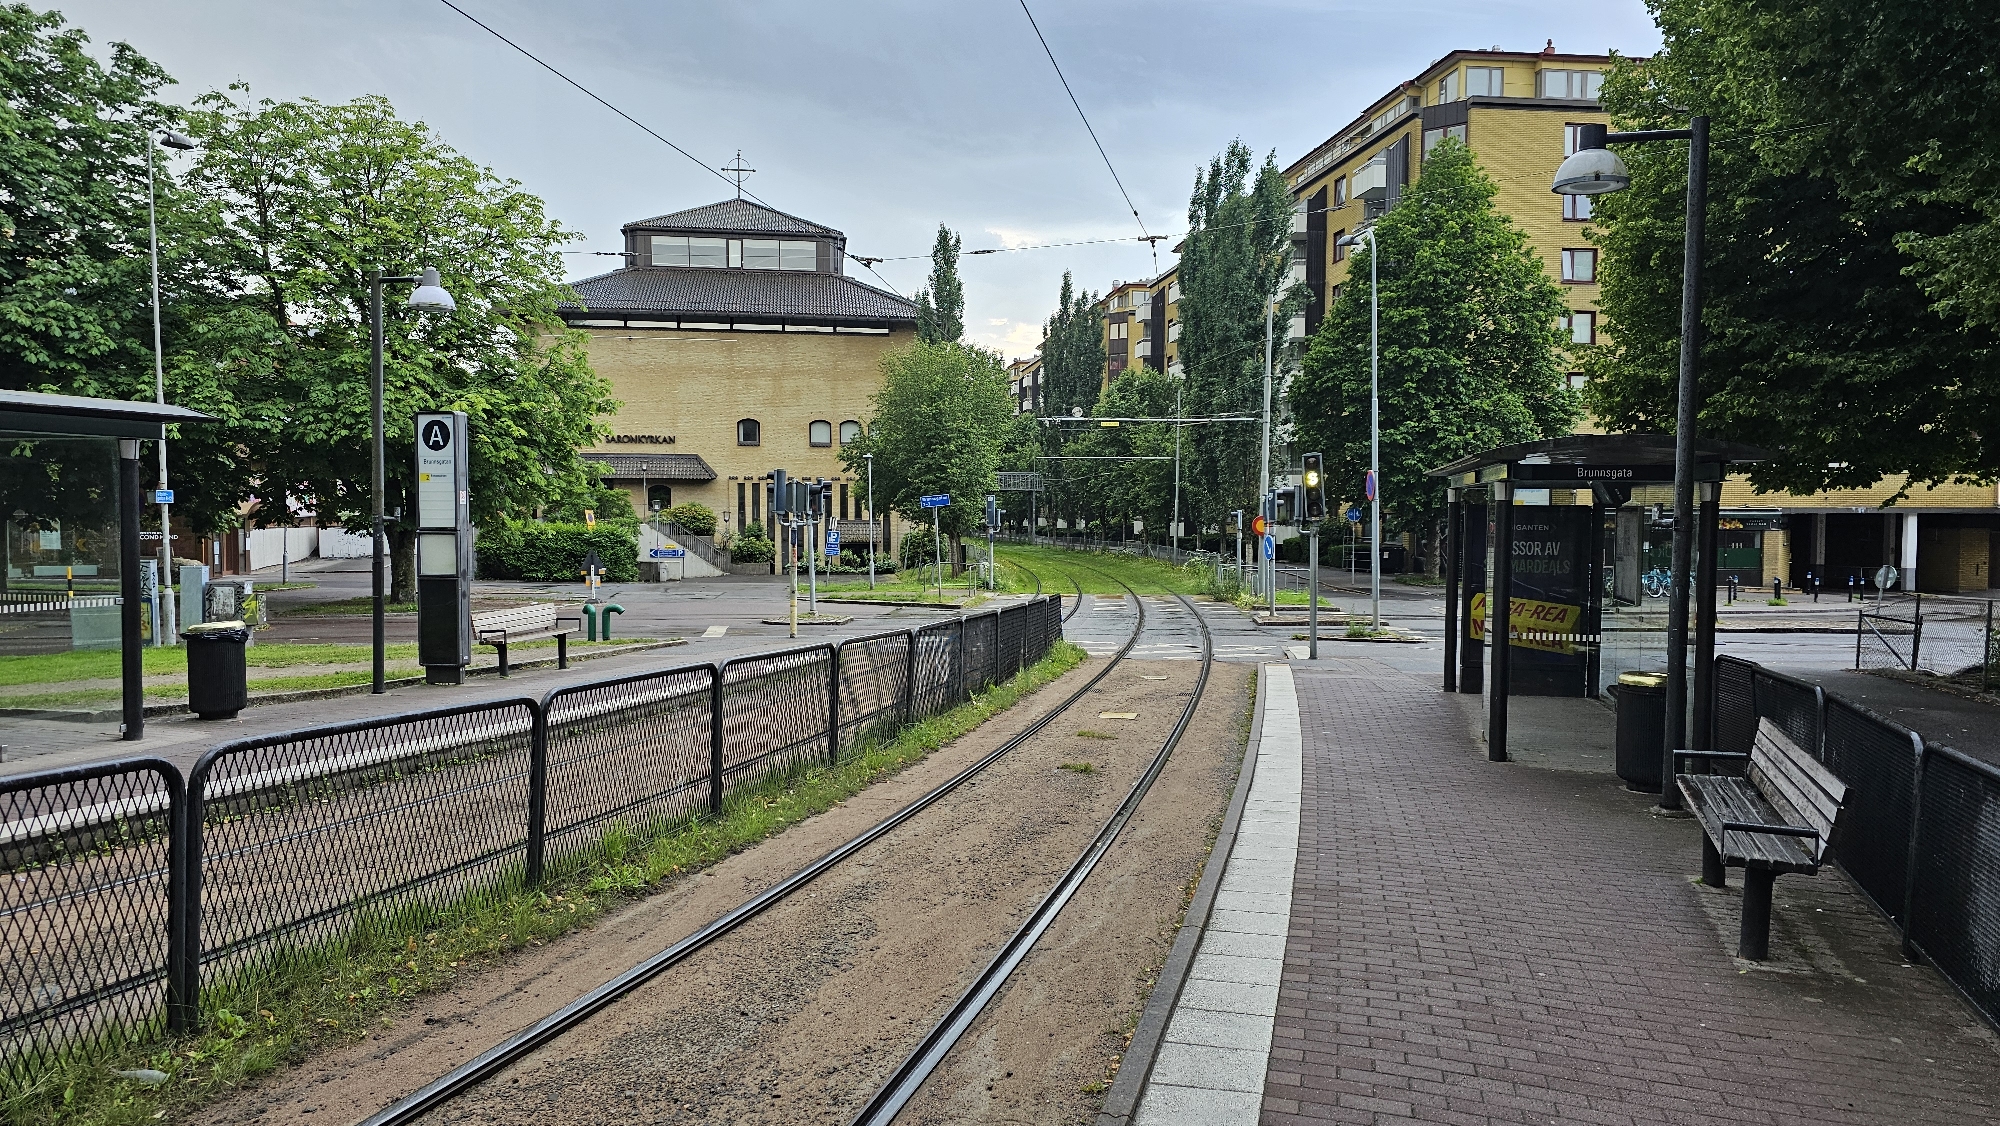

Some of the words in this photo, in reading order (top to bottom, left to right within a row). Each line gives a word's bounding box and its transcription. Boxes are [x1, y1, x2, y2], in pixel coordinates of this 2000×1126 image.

[429, 425, 444, 446] A
[605, 434, 676, 445] SARONKYRKAN
[1511, 541, 1542, 556] SSOR
[1545, 541, 1561, 556] AV
[1511, 559, 1571, 574] MARDEALS
